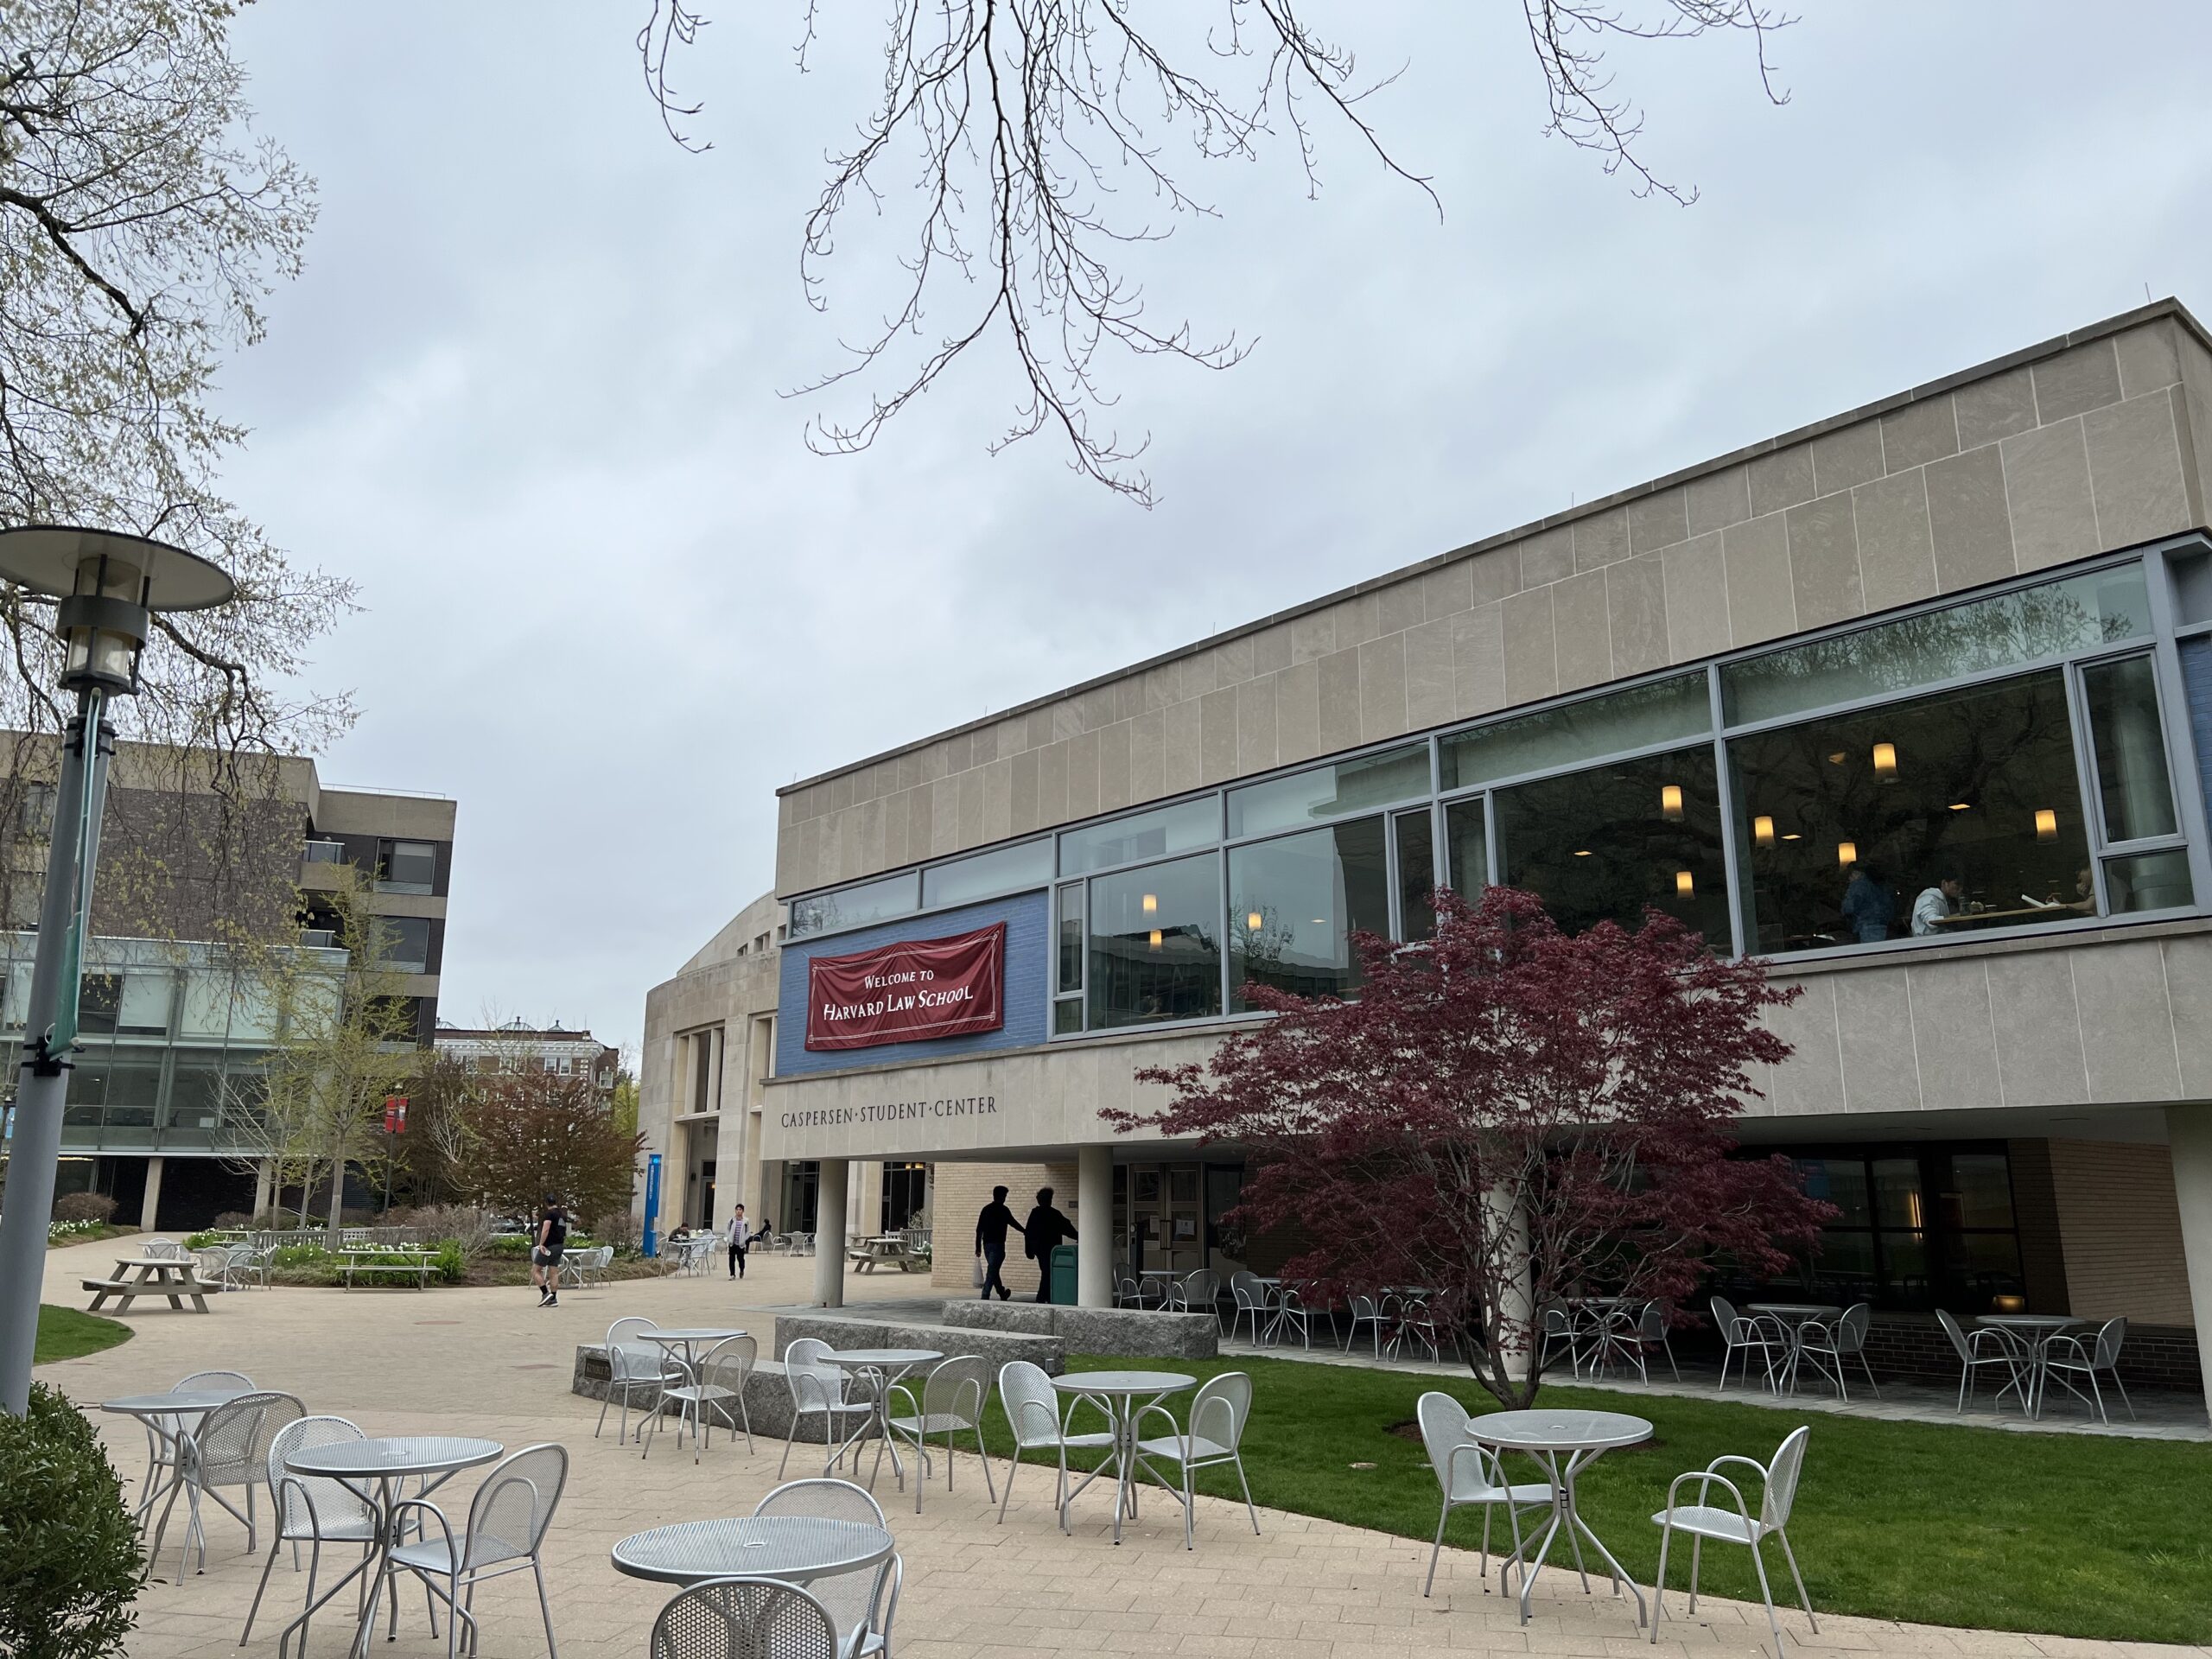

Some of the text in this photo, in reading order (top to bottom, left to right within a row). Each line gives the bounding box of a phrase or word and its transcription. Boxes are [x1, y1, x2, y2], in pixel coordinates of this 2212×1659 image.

[865, 969, 934, 989] WELCOME TO
[823, 985, 974, 1020] HARVARD LAW SCHOOL
[781, 1096, 997, 1128] CASPERSEN STUDENT CENTER
